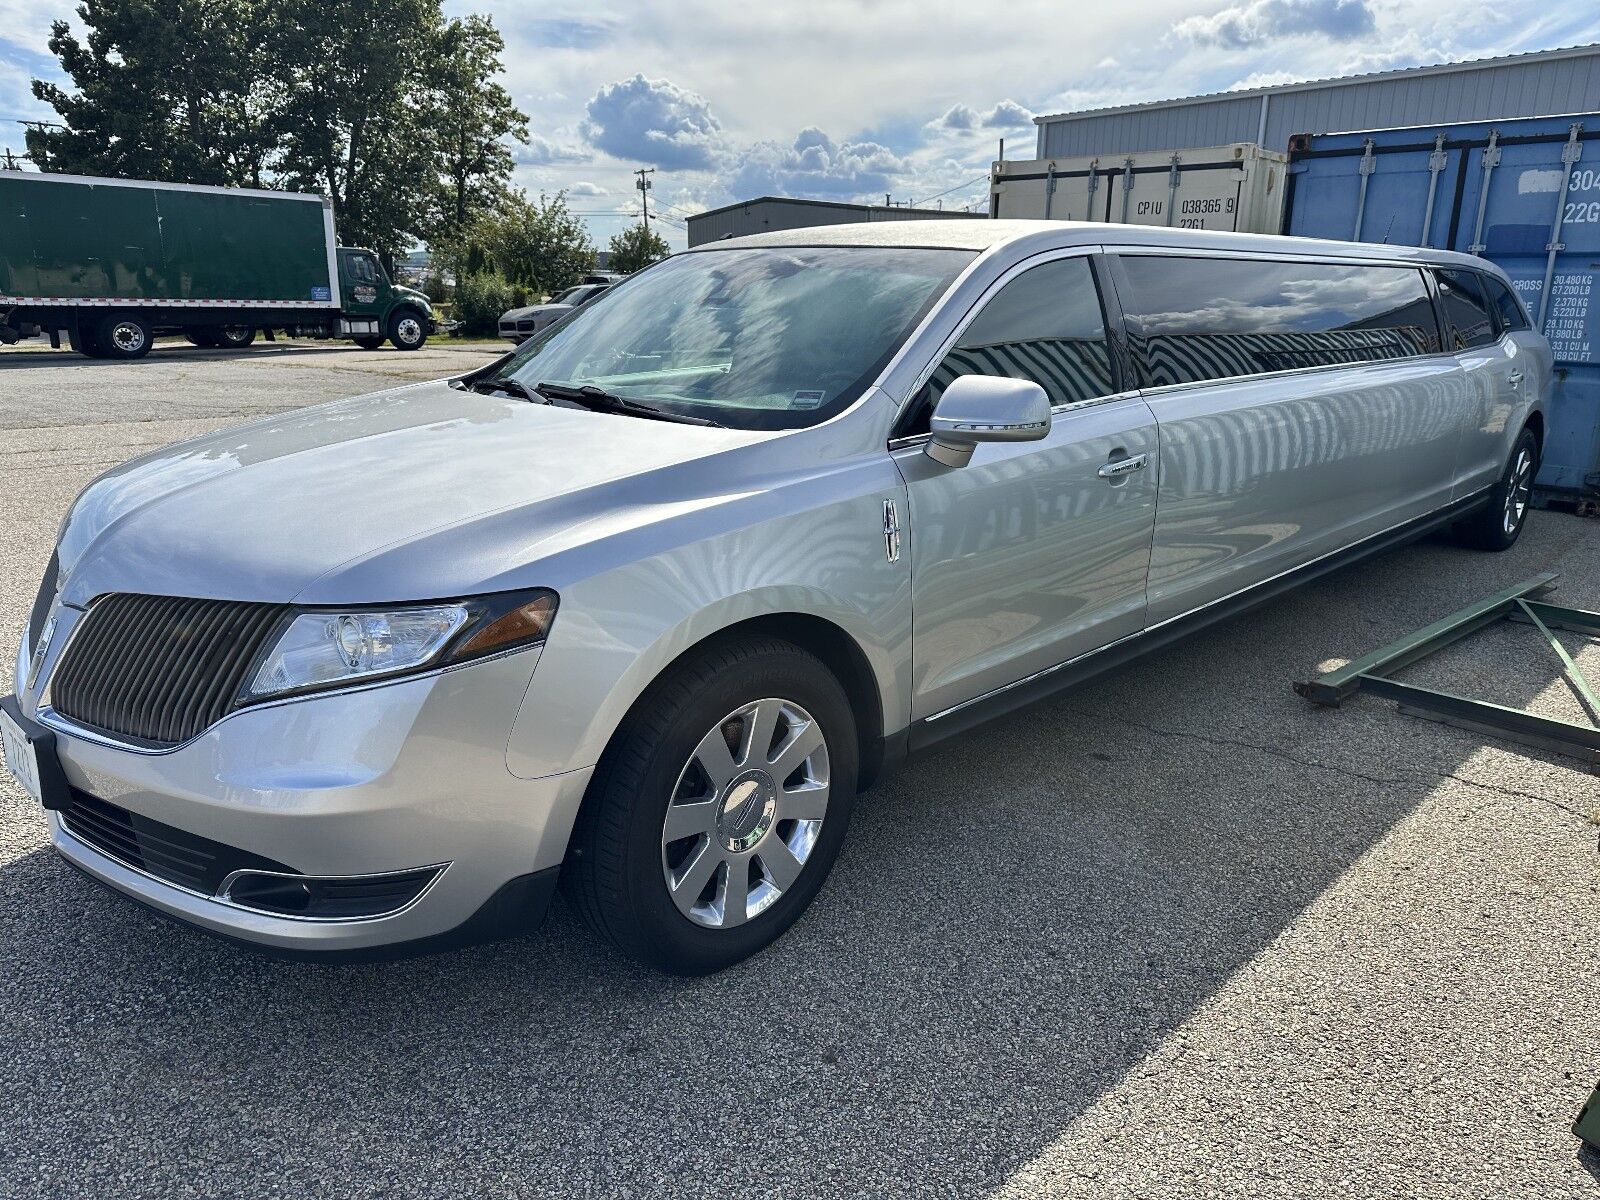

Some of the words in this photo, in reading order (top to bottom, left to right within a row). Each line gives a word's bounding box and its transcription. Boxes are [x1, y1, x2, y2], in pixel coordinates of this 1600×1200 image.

[1137, 201, 1162, 215] CPIU
[1182, 199, 1221, 214] 038365
[1226, 198, 1234, 213] 9
[1563, 202, 1600, 223] 22G
[1180, 219, 1205, 230] 22G1
[1553, 275, 1580, 285] 30.480
[1581, 275, 1593, 285] KG
[1513, 280, 1543, 291] GROSS
[1552, 286, 1579, 295] 67.200
[1580, 286, 1591, 295] LB
[1578, 298, 1589, 307] KG
[1553, 308, 1575, 317] 5.220
[1576, 308, 1587, 317] LB
[1546, 320, 1573, 329] 28.110
[1573, 320, 1584, 329] KG
[1572, 330, 1582, 339] LB
[1552, 341, 1568, 351] 33.1
